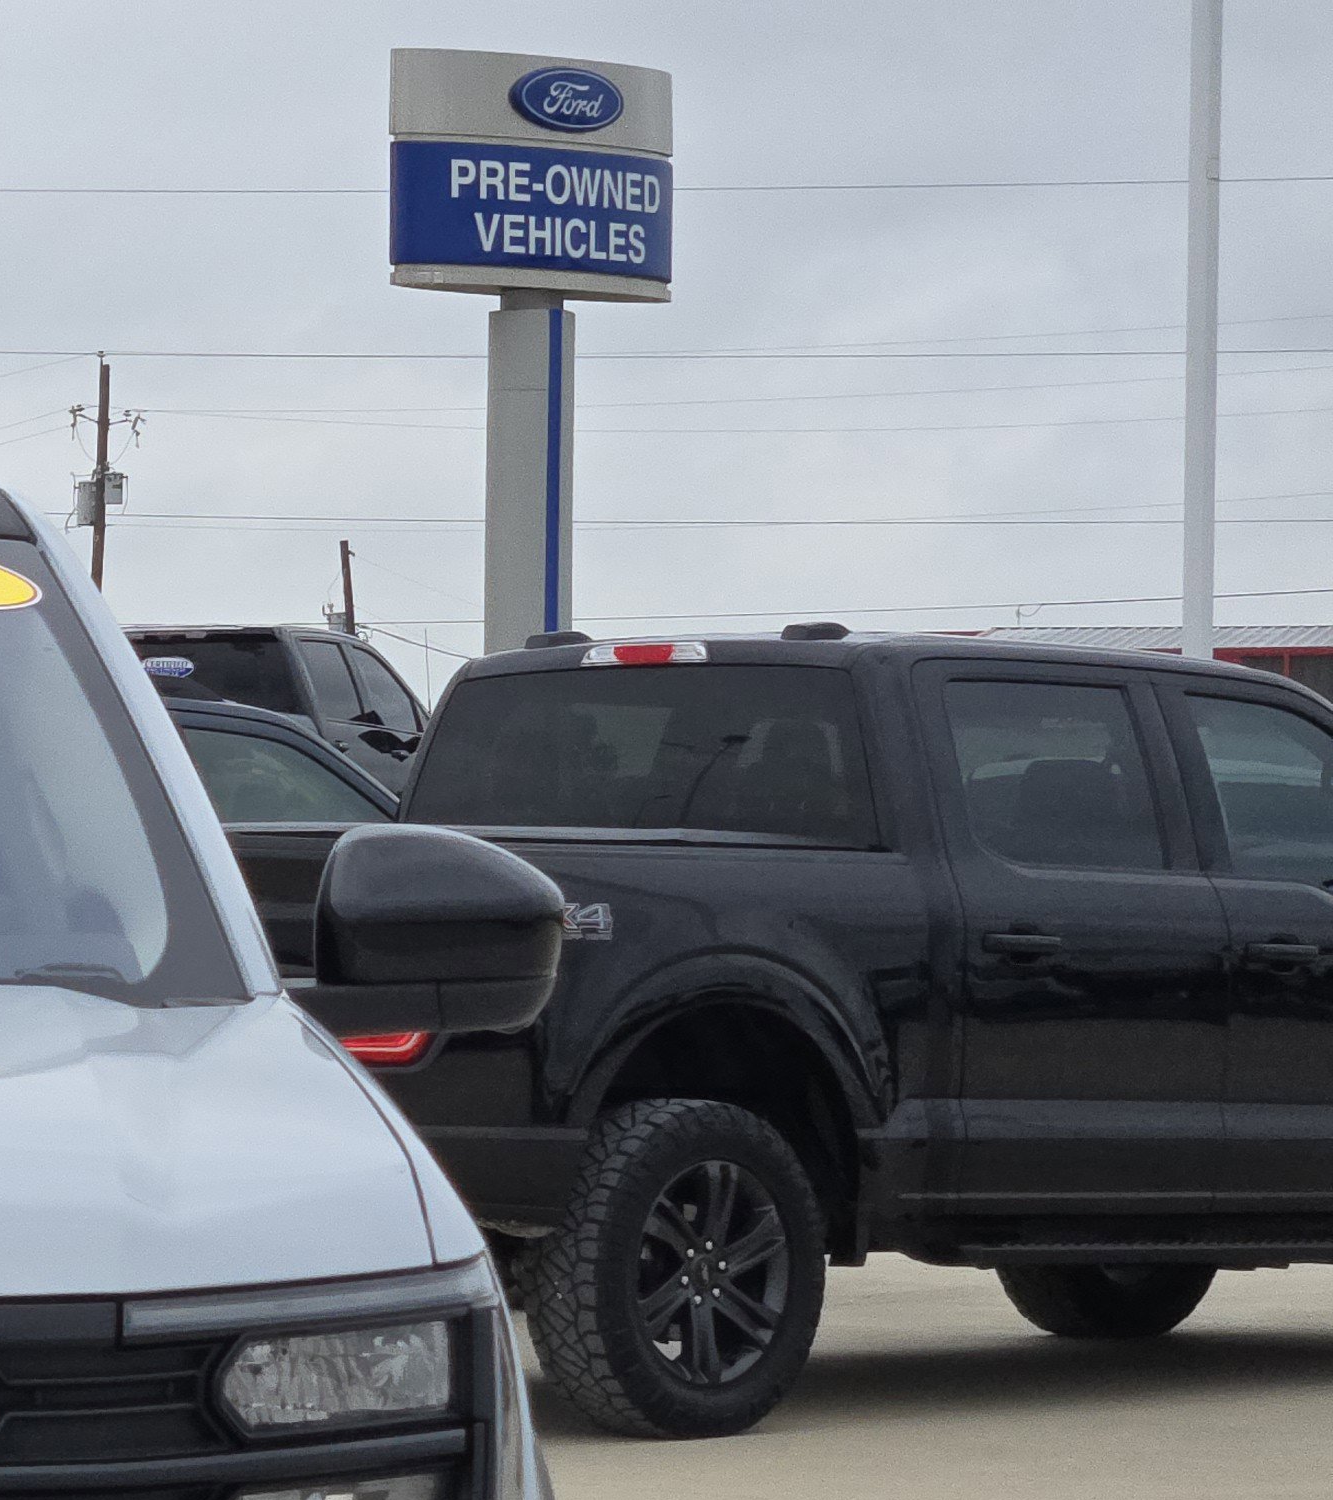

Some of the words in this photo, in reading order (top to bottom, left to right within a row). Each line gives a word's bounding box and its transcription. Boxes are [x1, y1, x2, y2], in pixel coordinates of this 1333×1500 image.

[543, 81, 603, 118] Ford
[450, 159, 660, 213] PRE-OWNED
[474, 212, 645, 263] VEHICLES
